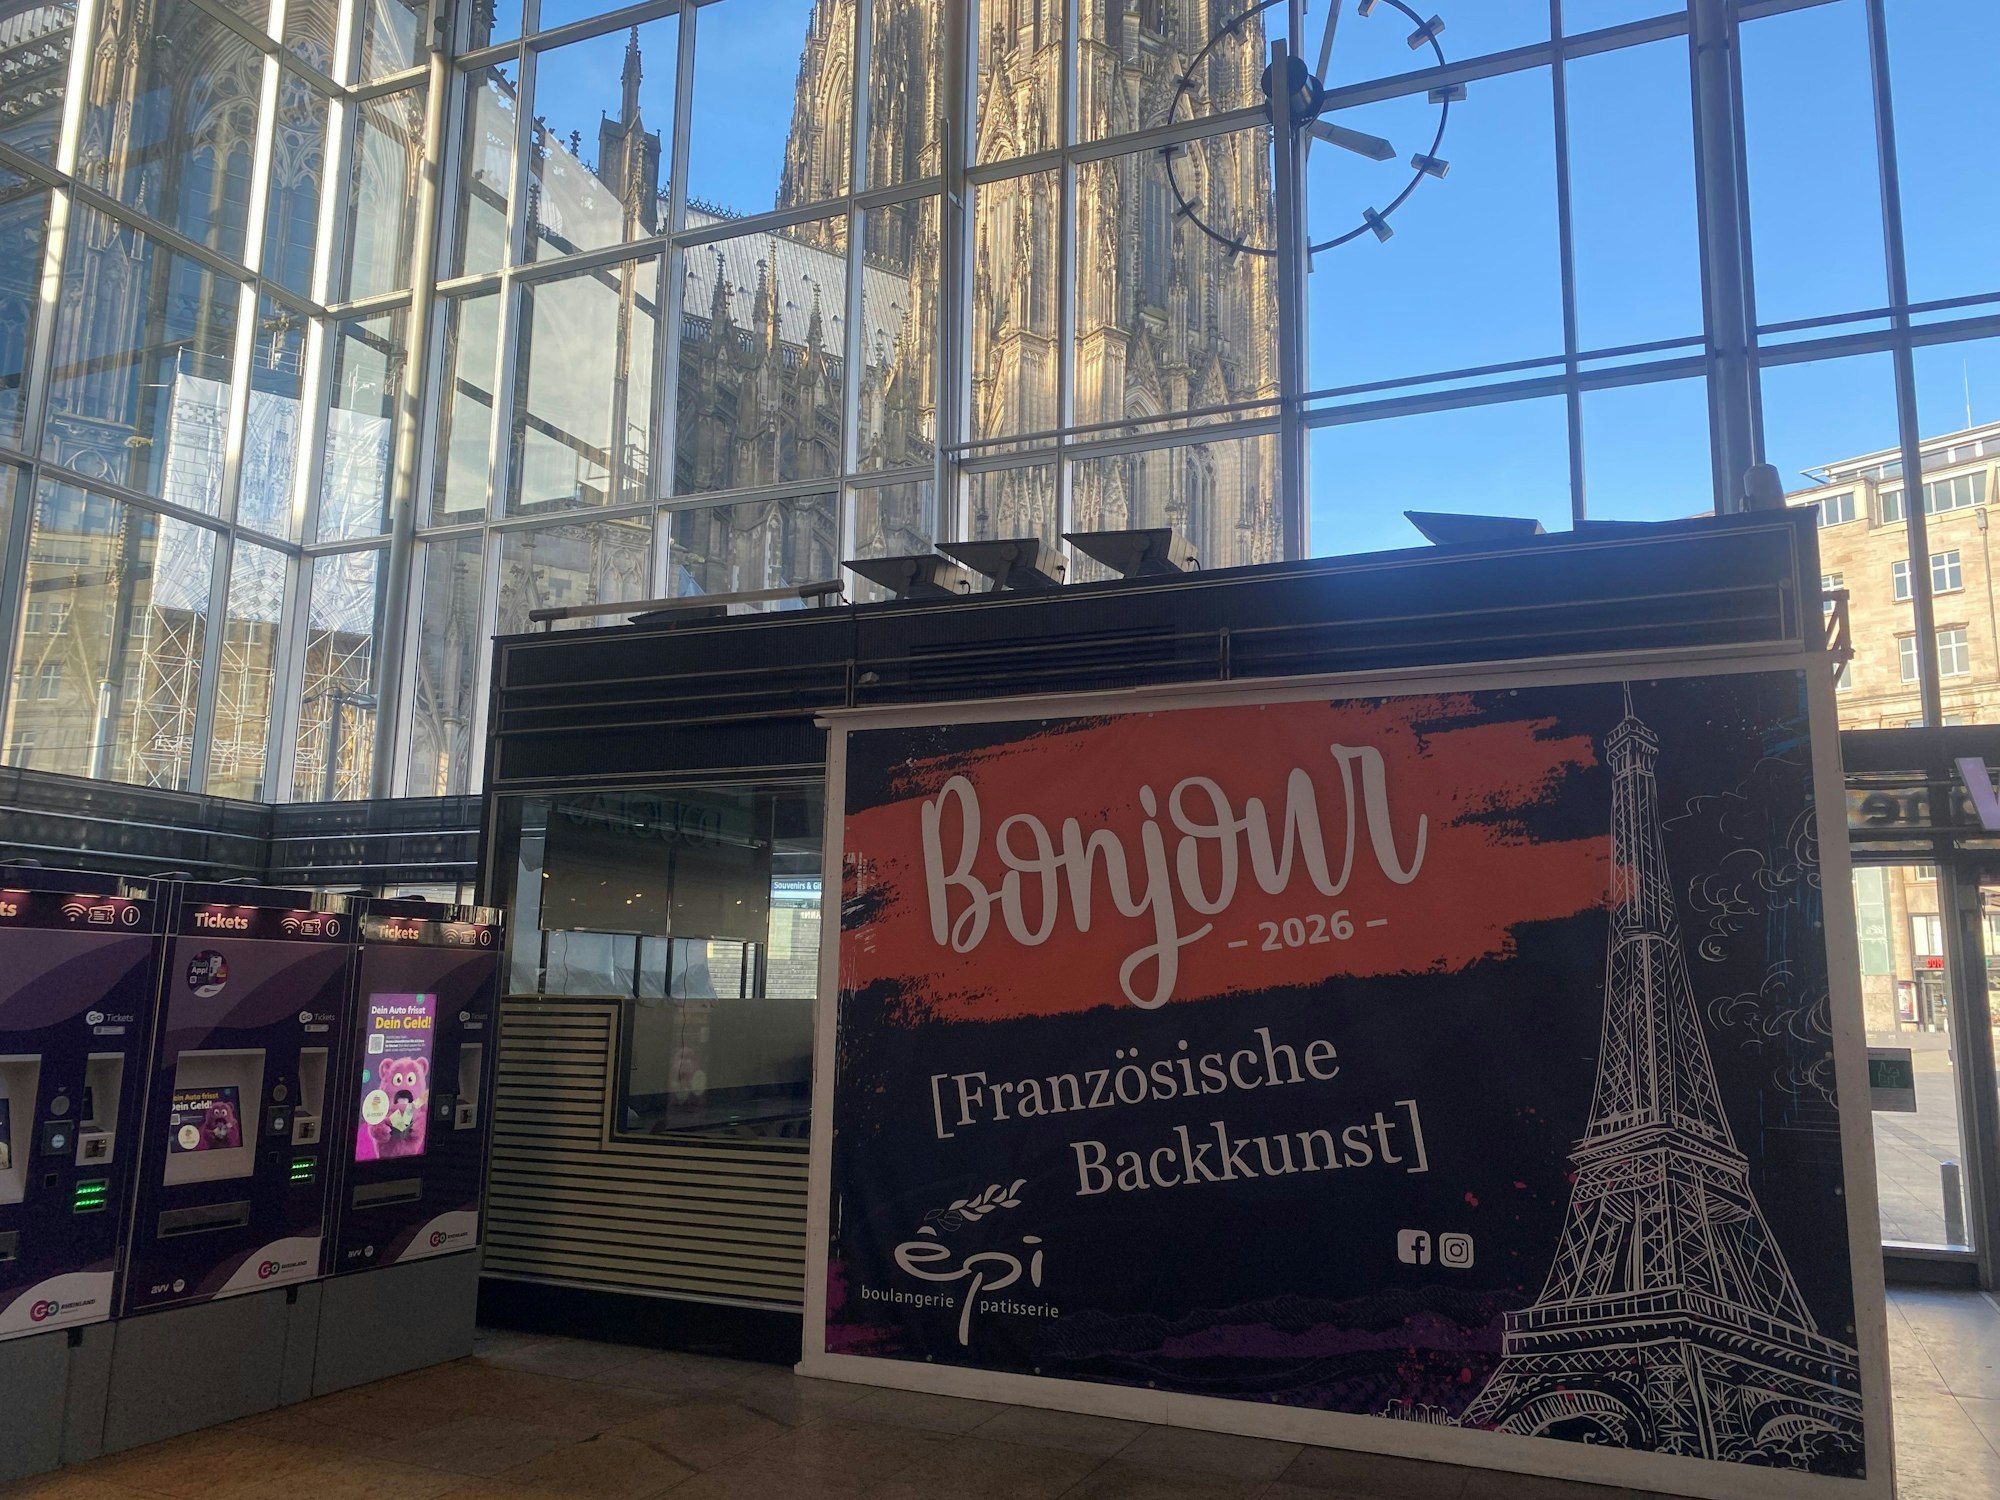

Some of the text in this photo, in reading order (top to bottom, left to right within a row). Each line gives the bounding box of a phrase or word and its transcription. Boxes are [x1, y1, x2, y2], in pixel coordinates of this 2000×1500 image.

[921, 744, 1428, 1010] Bonjour
[774, 882, 806, 890] Souvenirs
[195, 912, 249, 929] Tickets
[378, 925, 420, 940] Tickets
[1258, 909, 1355, 951] 2026
[106, 1013, 134, 1022] Tickets
[314, 1013, 336, 1021] Tickets
[371, 1006, 426, 1014] Dein Auto frisst
[375, 1016, 432, 1029] Dein Geld!
[930, 1027, 1340, 1139] [Französische
[190, 1101, 213, 1110] Geld!
[1070, 1099, 1429, 1196] Backkunst]
[151, 1283, 170, 1294] avv
[861, 1285, 955, 1308] boulangerie
[980, 1299, 1059, 1318] patisserie
